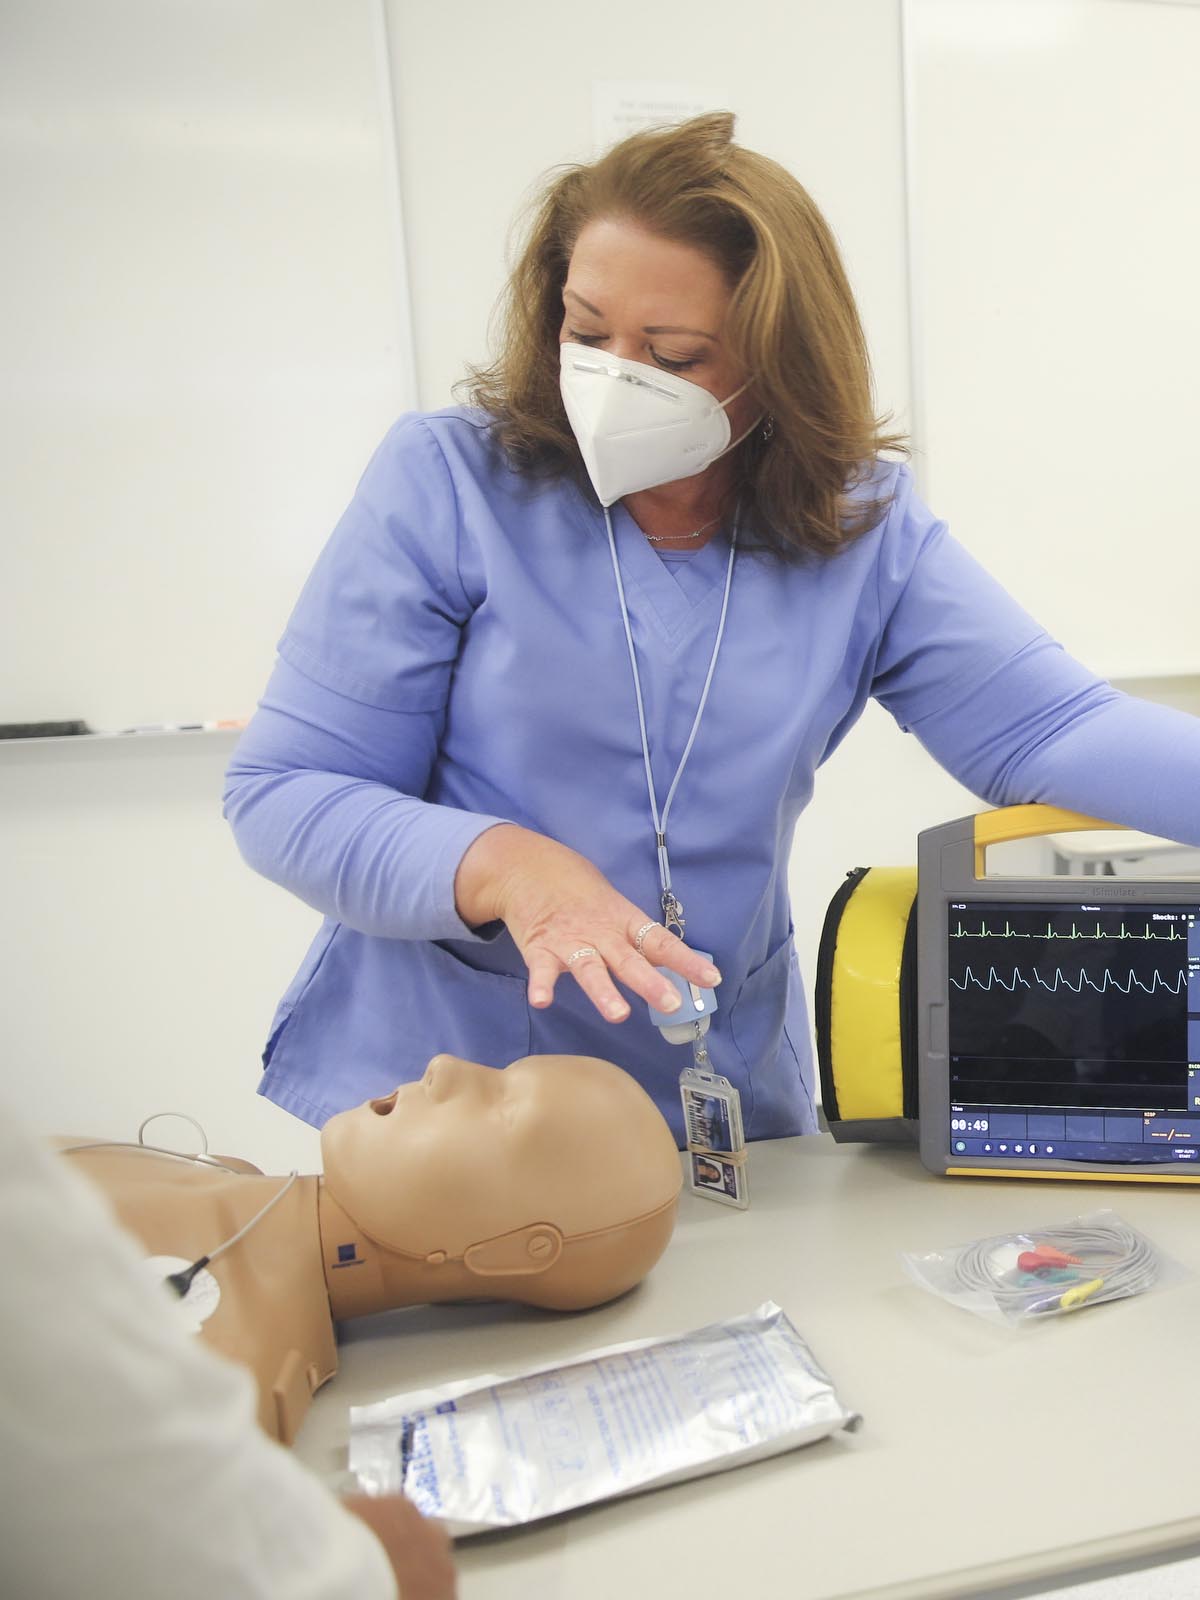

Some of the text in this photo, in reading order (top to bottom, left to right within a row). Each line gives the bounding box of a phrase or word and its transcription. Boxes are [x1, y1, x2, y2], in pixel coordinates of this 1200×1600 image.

[1093, 887, 1137, 897] iSimulate
[1152, 913, 1178, 921] Shocks:
[951, 1119, 989, 1132] 00:49
